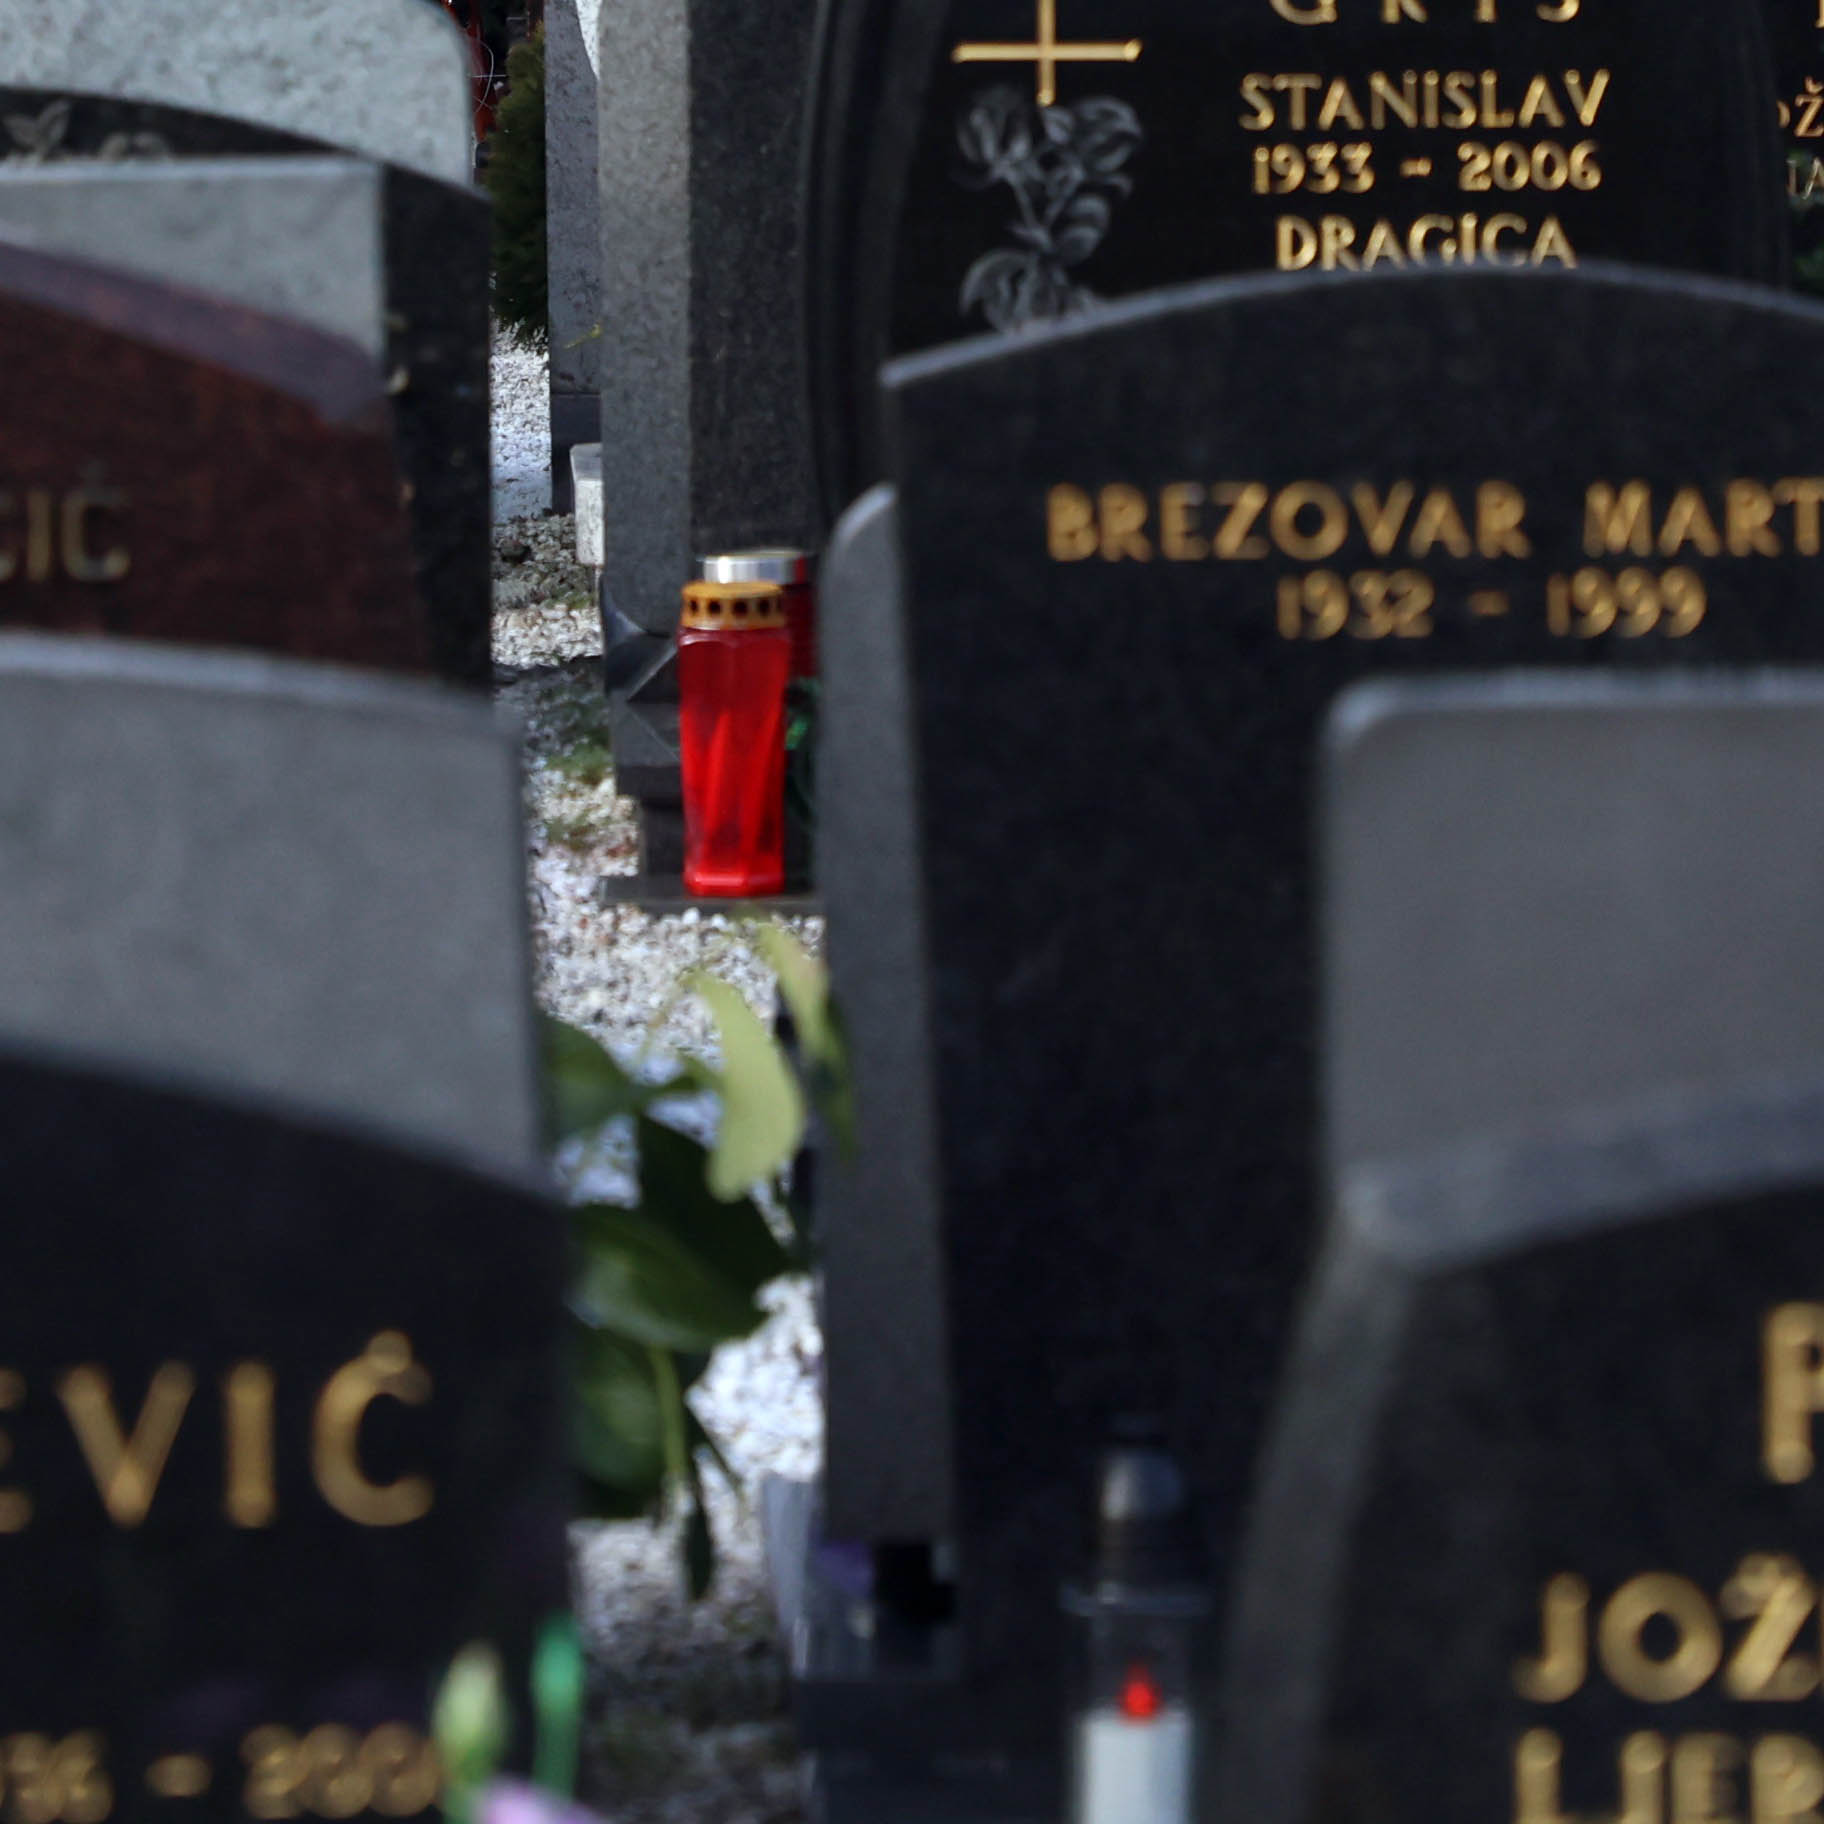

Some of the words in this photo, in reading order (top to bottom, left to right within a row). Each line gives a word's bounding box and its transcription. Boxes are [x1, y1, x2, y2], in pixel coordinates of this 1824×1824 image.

[1238, 69, 1610, 132] STANISLAV
[1251, 141, 1376, 195] 1933
[1457, 140, 1603, 192] 2006
[1275, 212, 1580, 272] DRAGICA
[1044, 479, 1530, 563] BREZOVAR
[1275, 571, 1434, 640] 1932
[1545, 567, 1708, 638] 1999
